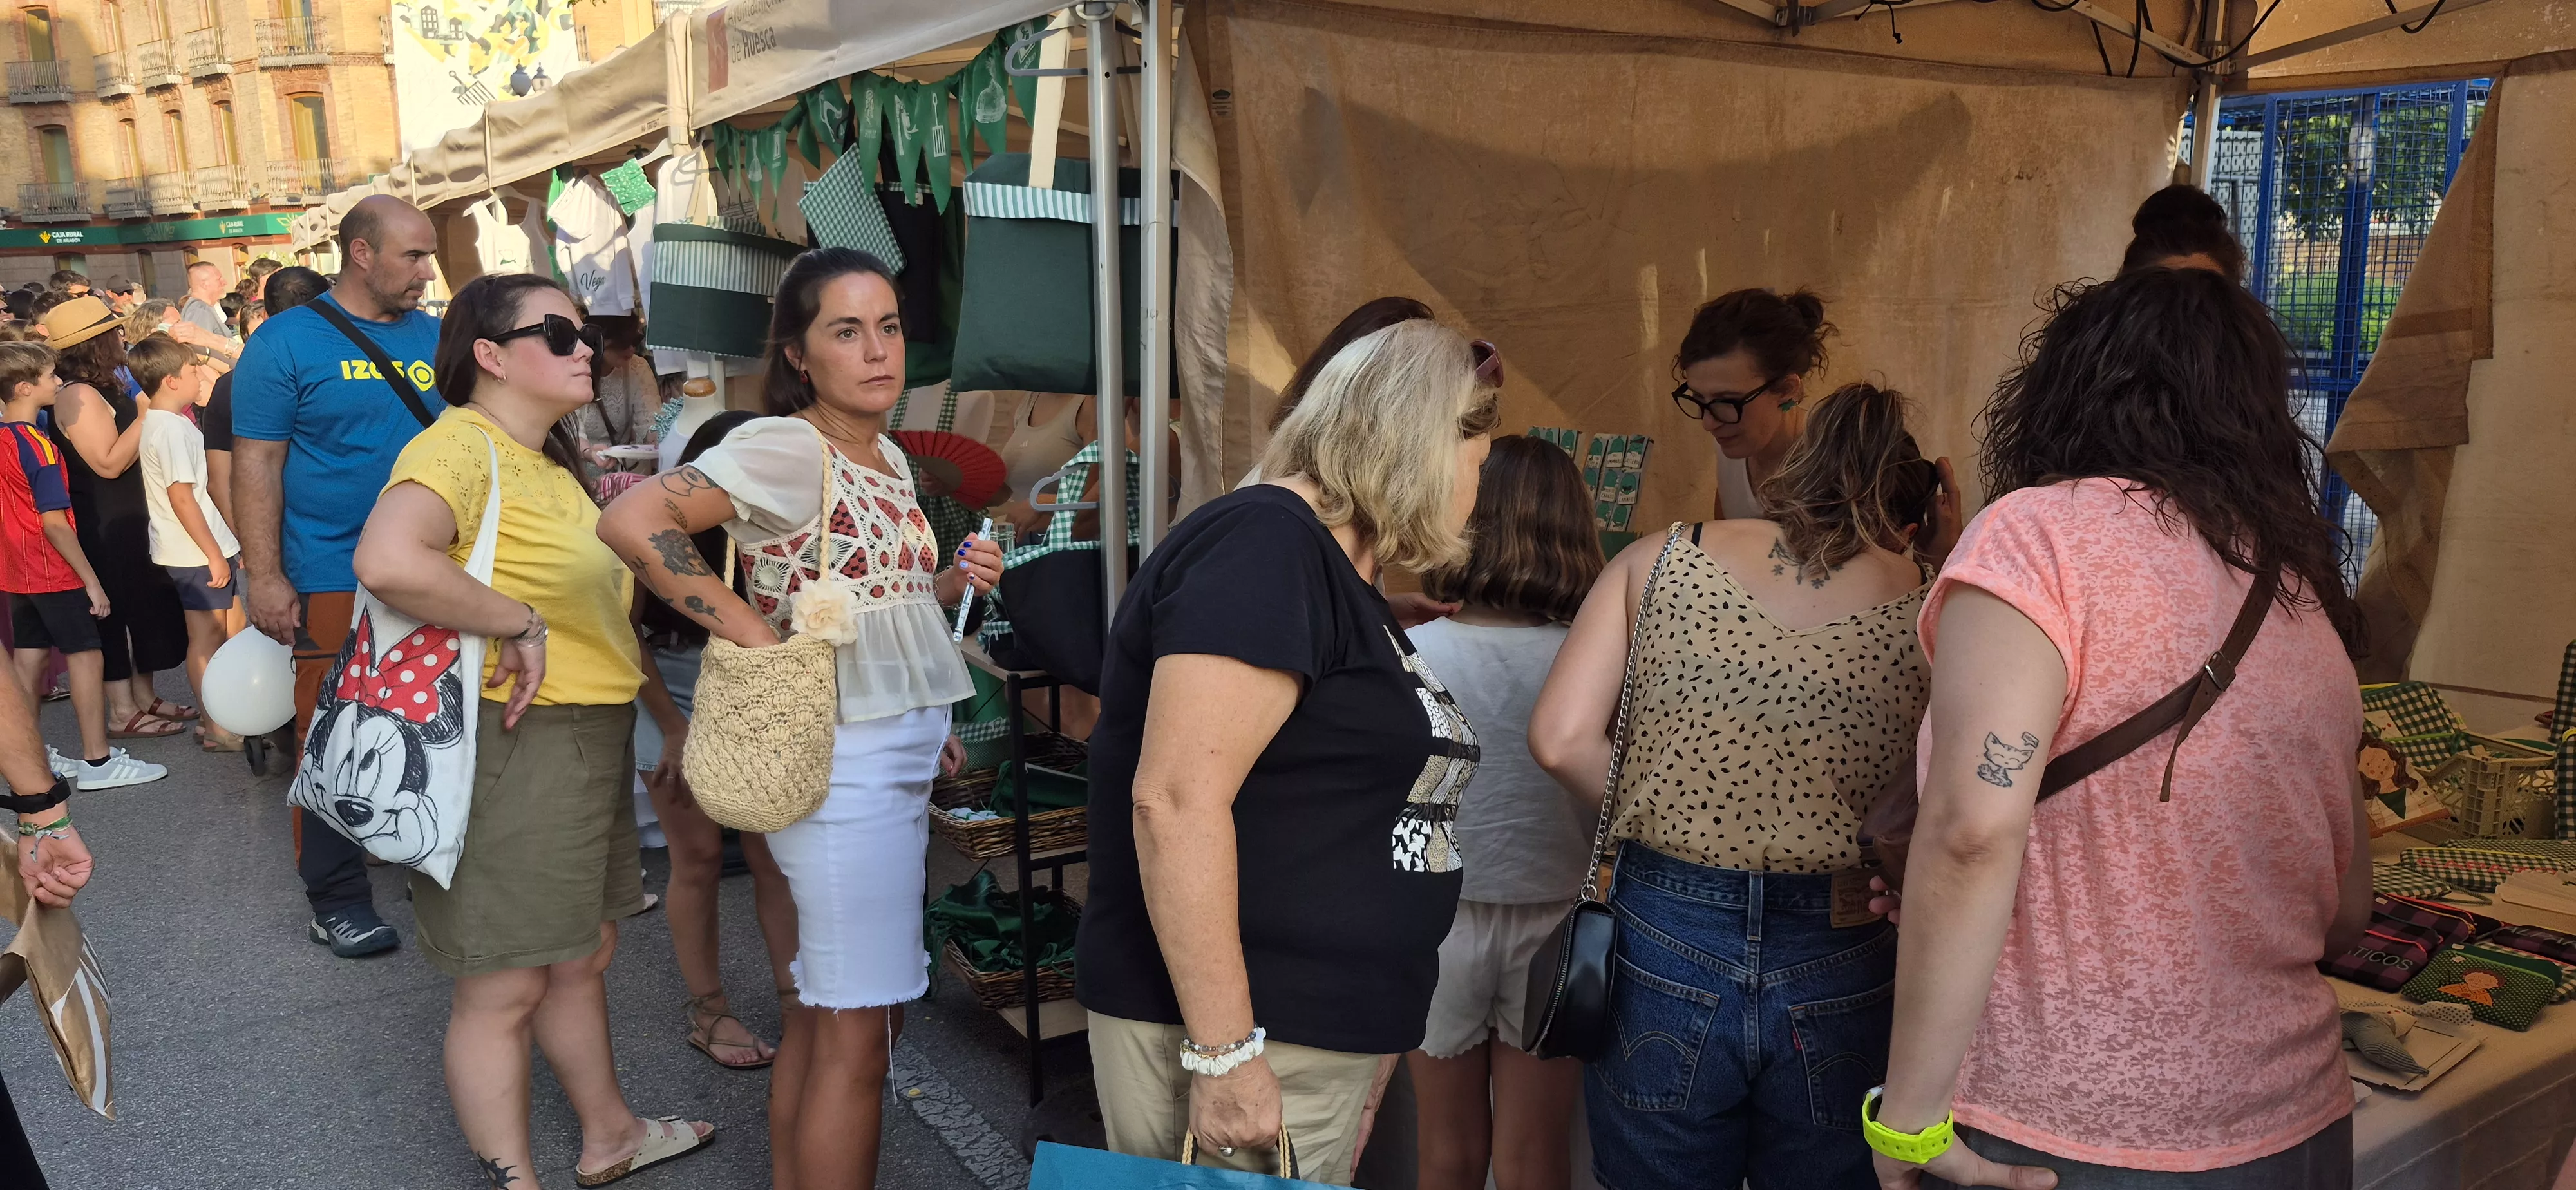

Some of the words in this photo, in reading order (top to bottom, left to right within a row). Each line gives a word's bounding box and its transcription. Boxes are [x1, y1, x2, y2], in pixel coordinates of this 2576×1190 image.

[728, 0, 785, 32] Ayuntamien
[731, 36, 741, 64] de
[741, 26, 777, 59] Huesca
[580, 269, 606, 292] Vega
[2347, 945, 2414, 970] TICOS
